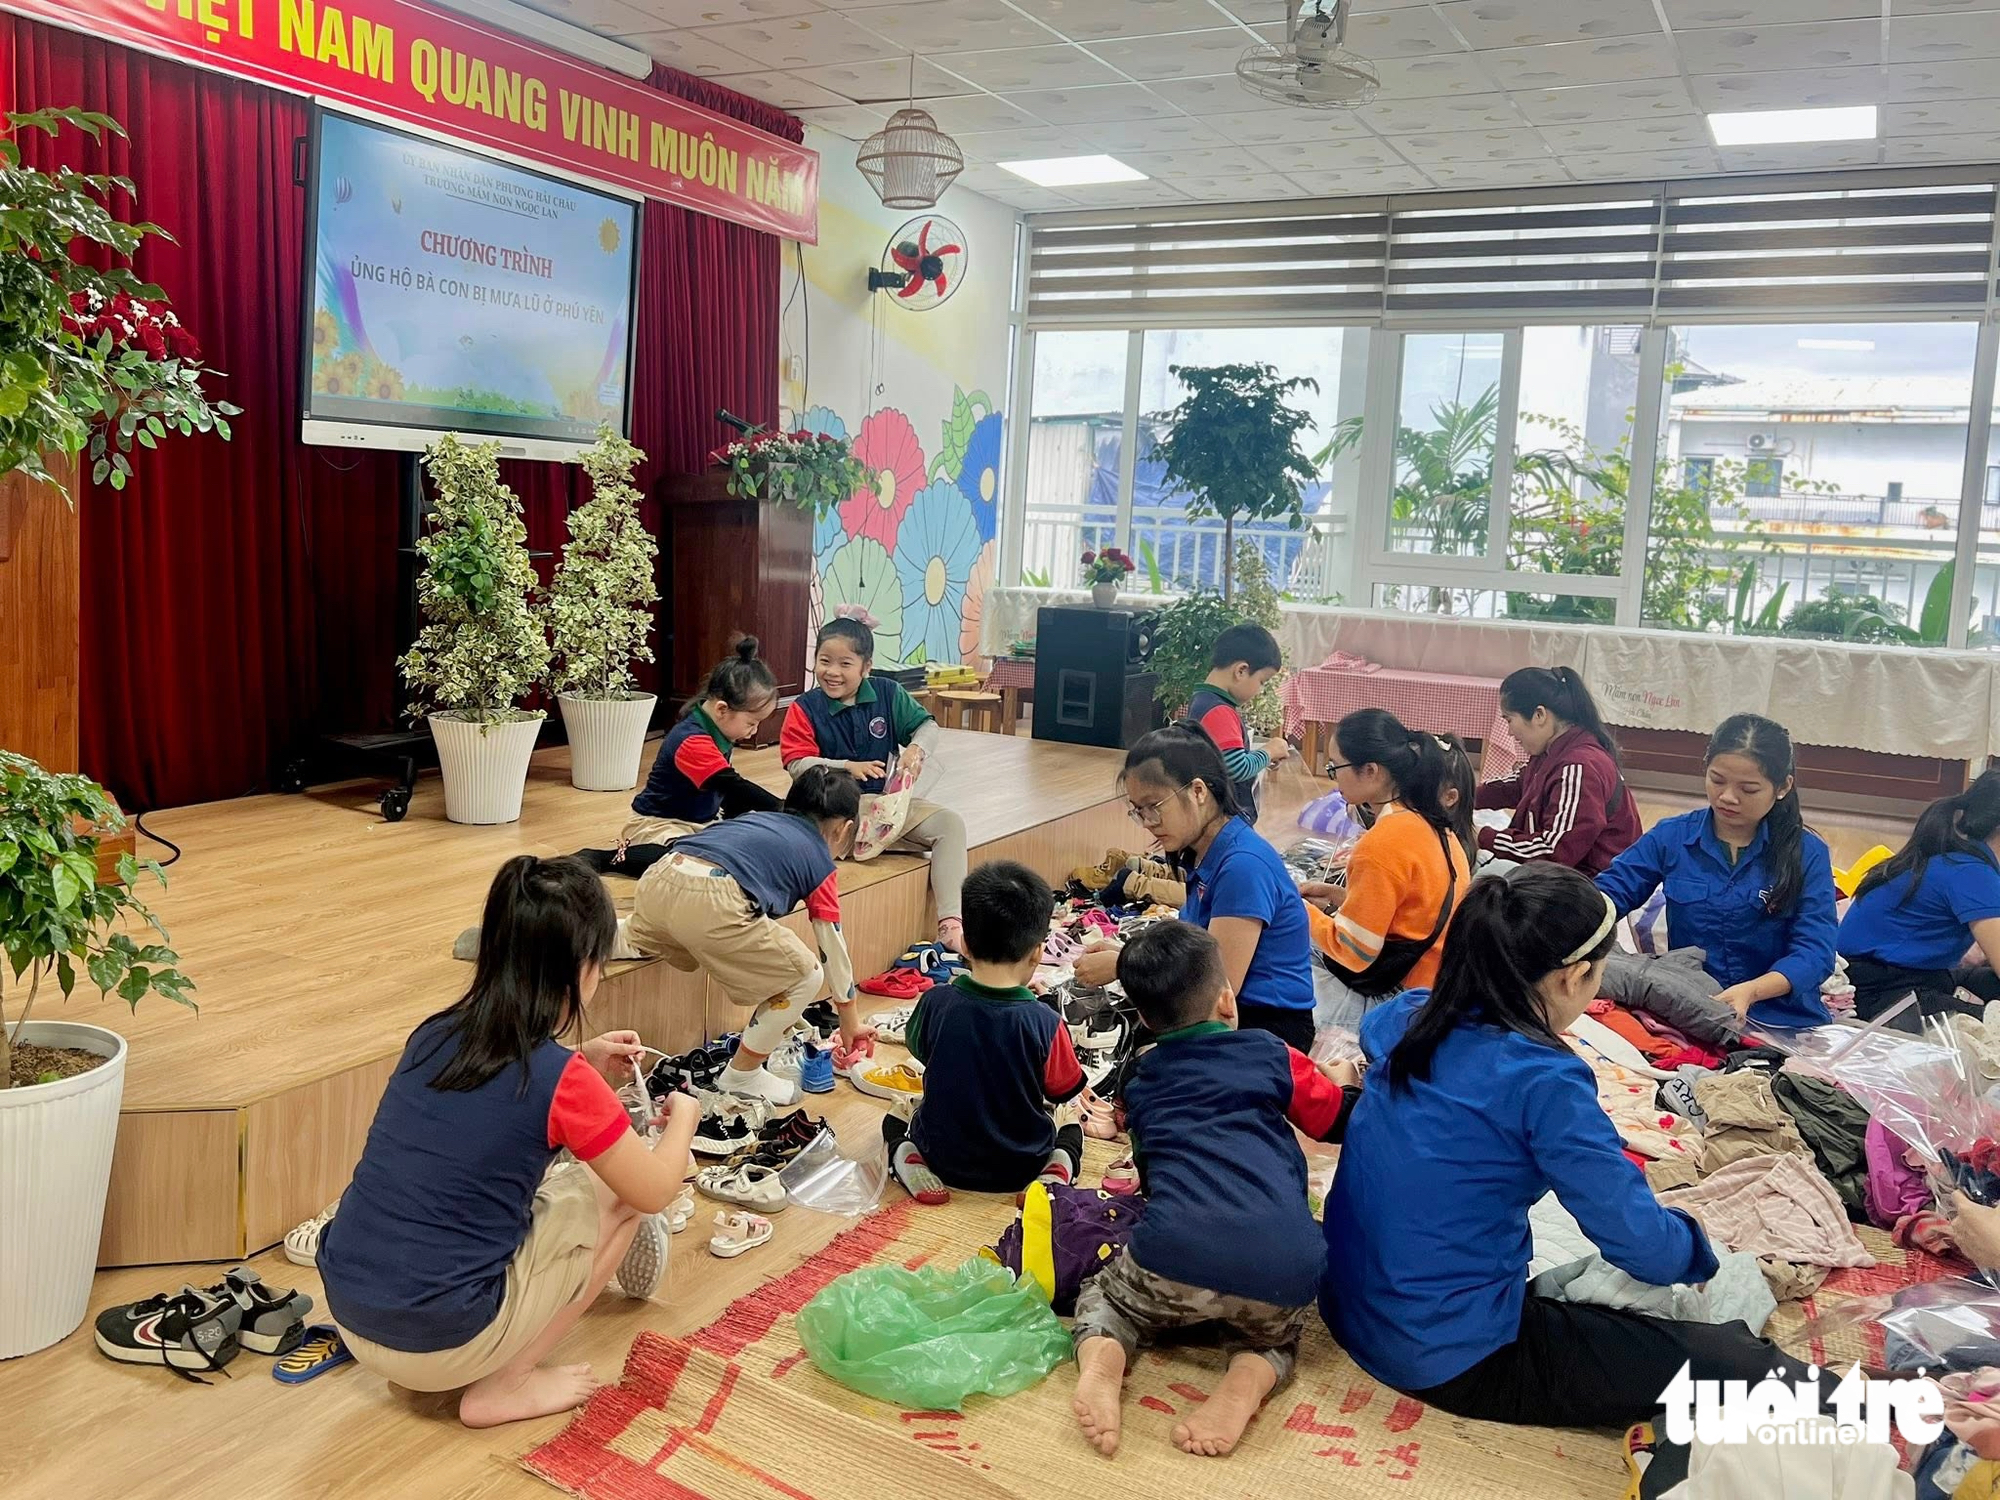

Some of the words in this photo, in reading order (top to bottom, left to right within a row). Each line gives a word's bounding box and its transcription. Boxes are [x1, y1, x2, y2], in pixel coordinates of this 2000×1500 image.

[279, 0, 394, 84] NAM
[411, 38, 547, 133] QUANG
[559, 88, 640, 163] VINH
[649, 122, 738, 195] MUÔN
[745, 155, 804, 217] NĂM
[419, 158, 441, 174] BAN
[492, 192, 513, 207] NON
[515, 199, 540, 215] NGỌC
[541, 206, 559, 219] LAN
[420, 229, 497, 267] CHƯƠNG
[501, 245, 554, 279] TRÌNH
[351, 254, 385, 282] ỦNG
[390, 266, 412, 291] HỘ
[416, 271, 435, 292] BÀ
[439, 278, 469, 299] CON
[473, 285, 487, 306] BỊ
[490, 288, 522, 309] MƯA
[524, 293, 540, 312] LŨ
[543, 294, 554, 314] Ở
[556, 301, 580, 319] PHÚ
[583, 304, 605, 324] YÊN
